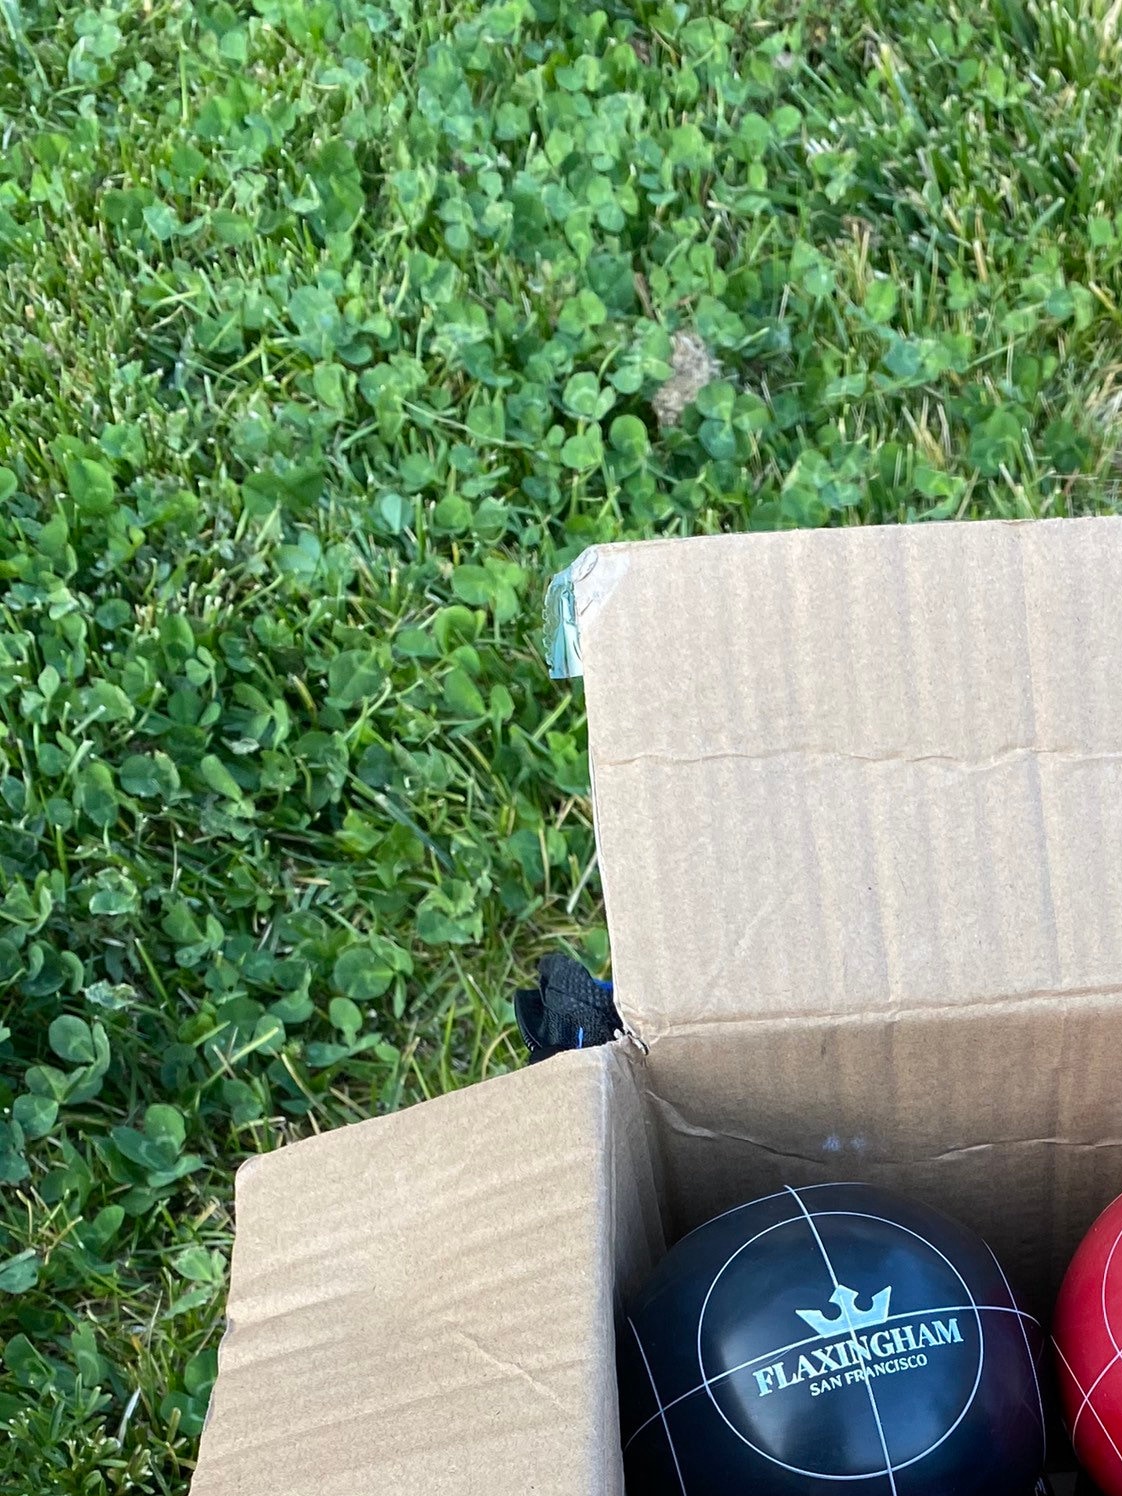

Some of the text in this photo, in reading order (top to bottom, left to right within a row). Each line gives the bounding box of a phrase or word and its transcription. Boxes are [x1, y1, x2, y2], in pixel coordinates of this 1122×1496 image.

[752, 1317, 964, 1397] FLAXINGHAM
[809, 1353, 928, 1397] SAN FRANCISCO
